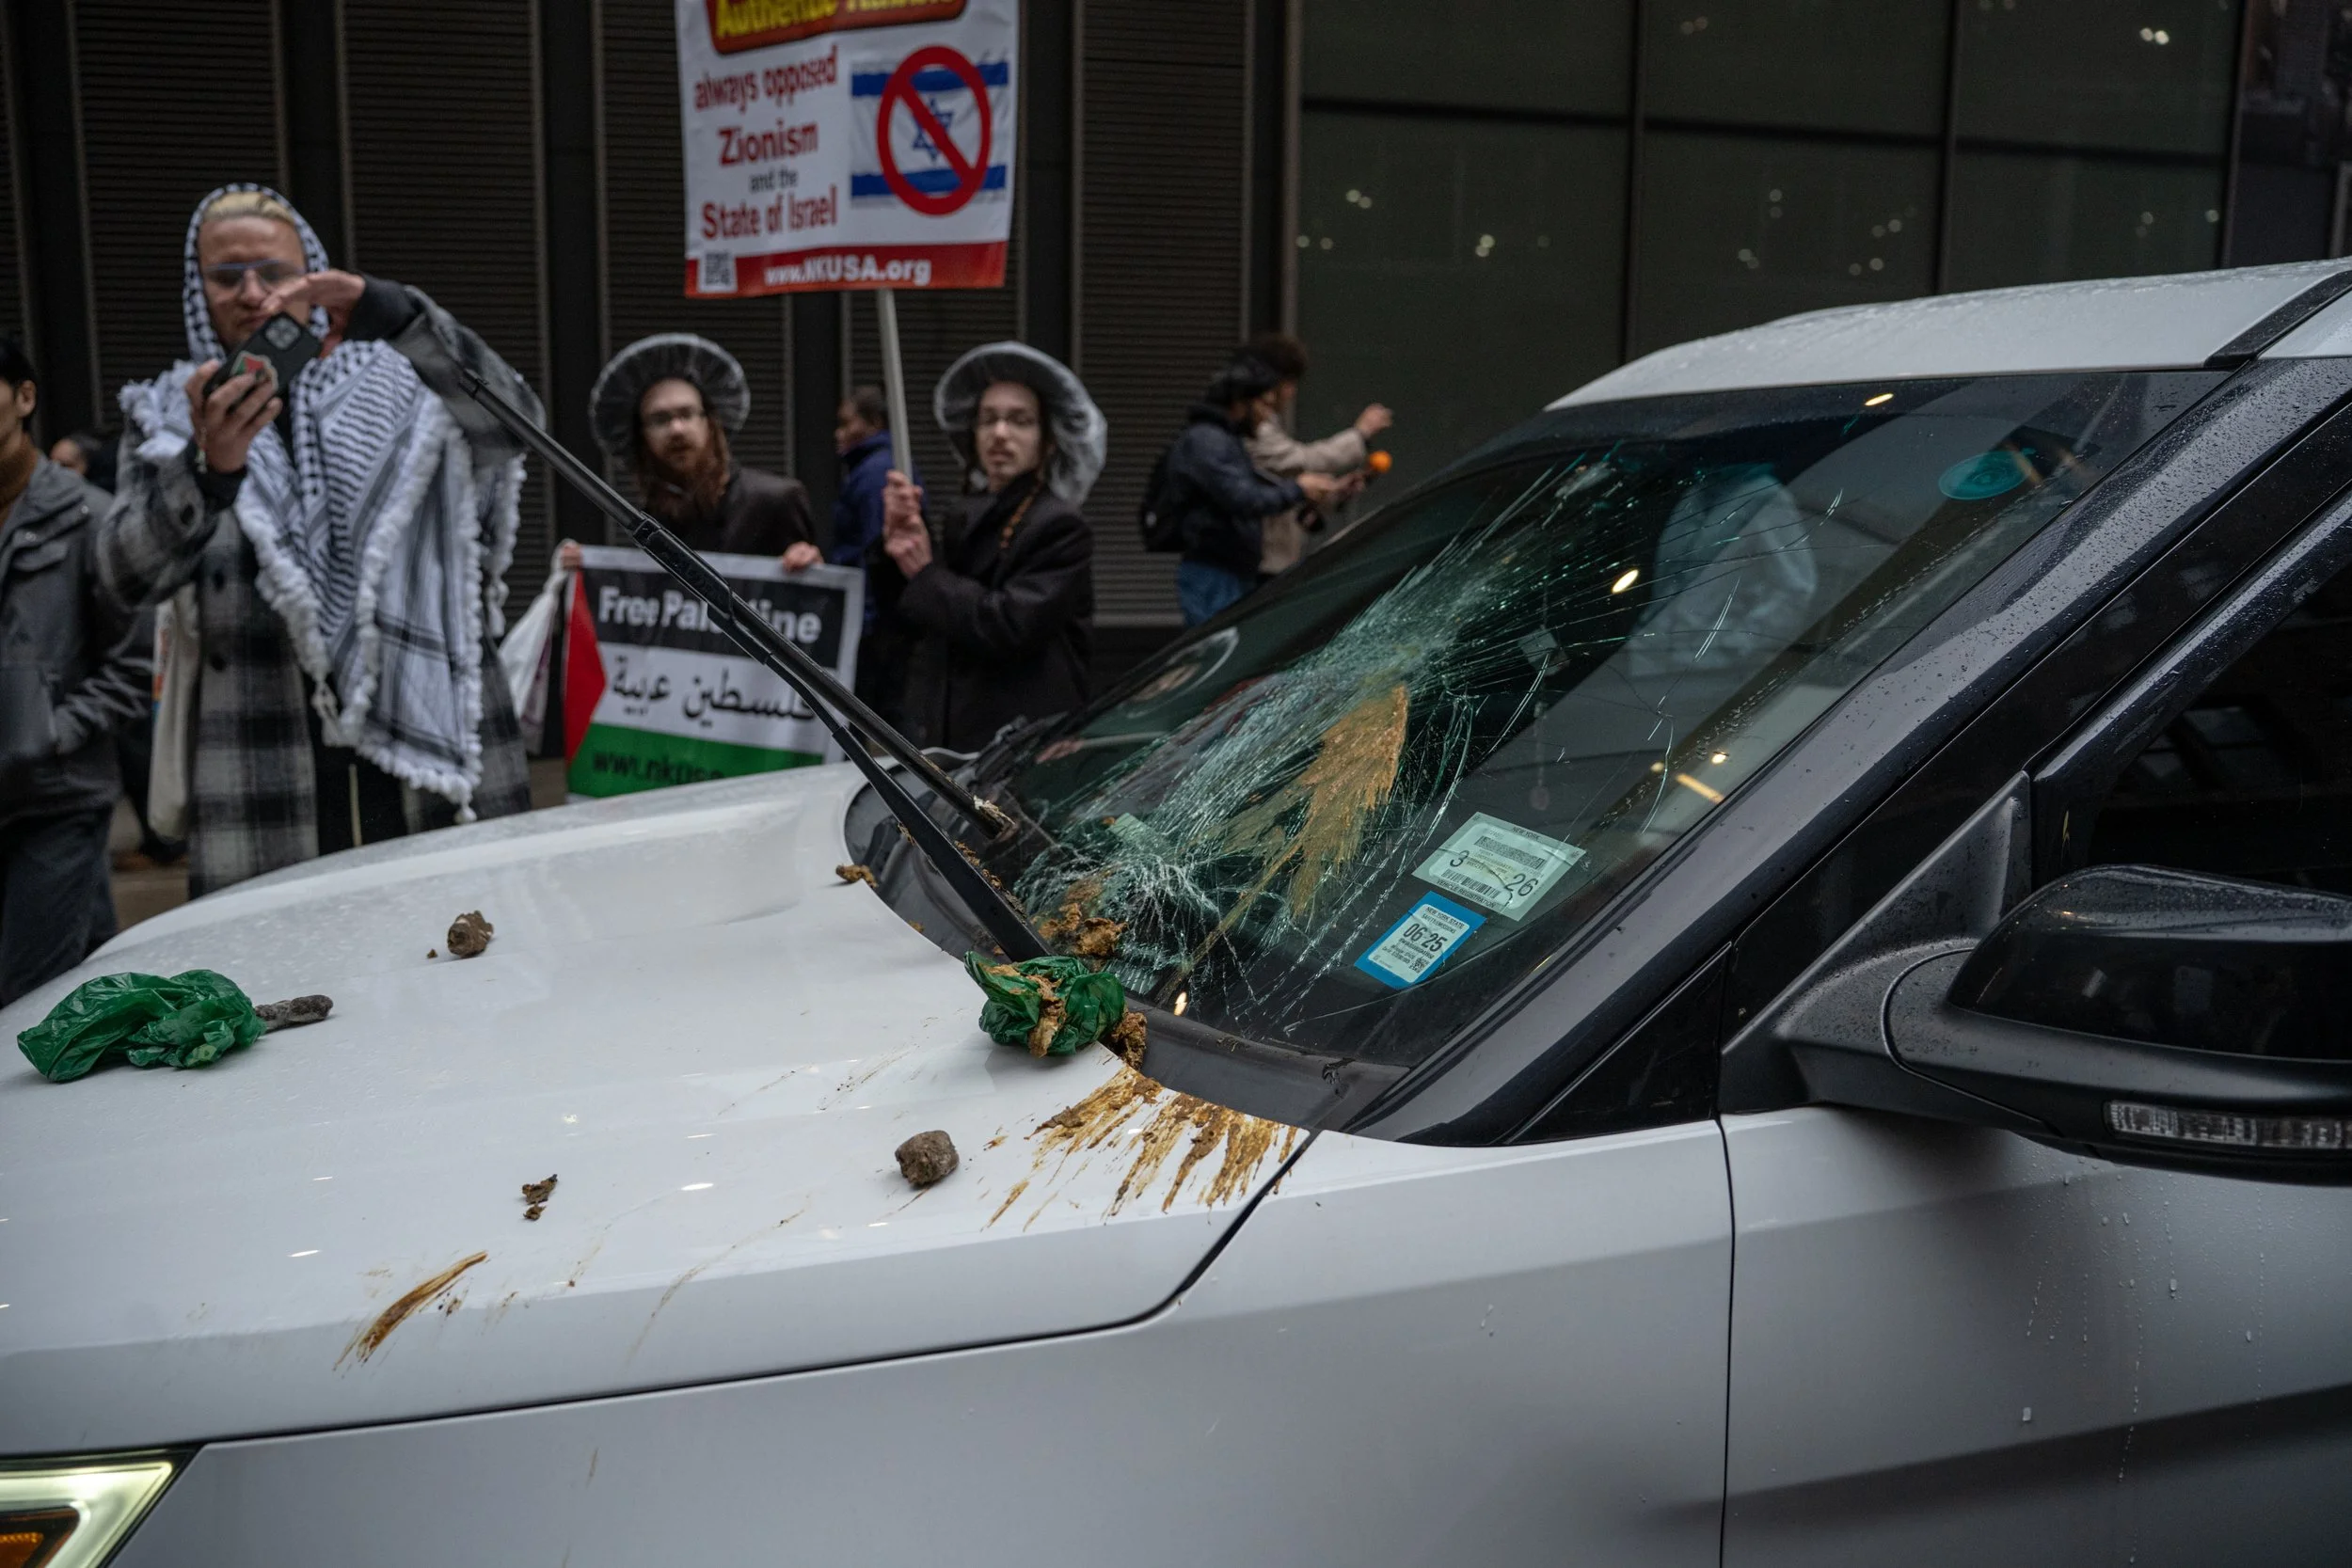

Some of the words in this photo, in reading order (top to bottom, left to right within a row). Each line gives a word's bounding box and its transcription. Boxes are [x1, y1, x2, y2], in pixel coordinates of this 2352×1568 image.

[695, 69, 758, 114] always
[764, 43, 837, 107] opposed
[718, 118, 818, 166] Zionism
[750, 168, 774, 193] and
[778, 168, 798, 188] the
[702, 198, 760, 240] State
[767, 192, 784, 233] of
[788, 183, 837, 229] Israel
[764, 254, 931, 287] www.NKUSA.org
[598, 584, 660, 628] Free
[661, 589, 822, 643] Paline
[1524, 831, 1541, 842] YORK
[1437, 879, 1459, 893] VEHICLE
[1458, 887, 1496, 909] REGISTRATION
[1504, 873, 1539, 897] 26
[1437, 911, 1451, 922] YORK
[1449, 917, 1465, 929] STATE
[1403, 923, 1428, 942] 06
[1421, 932, 1448, 953] 25
